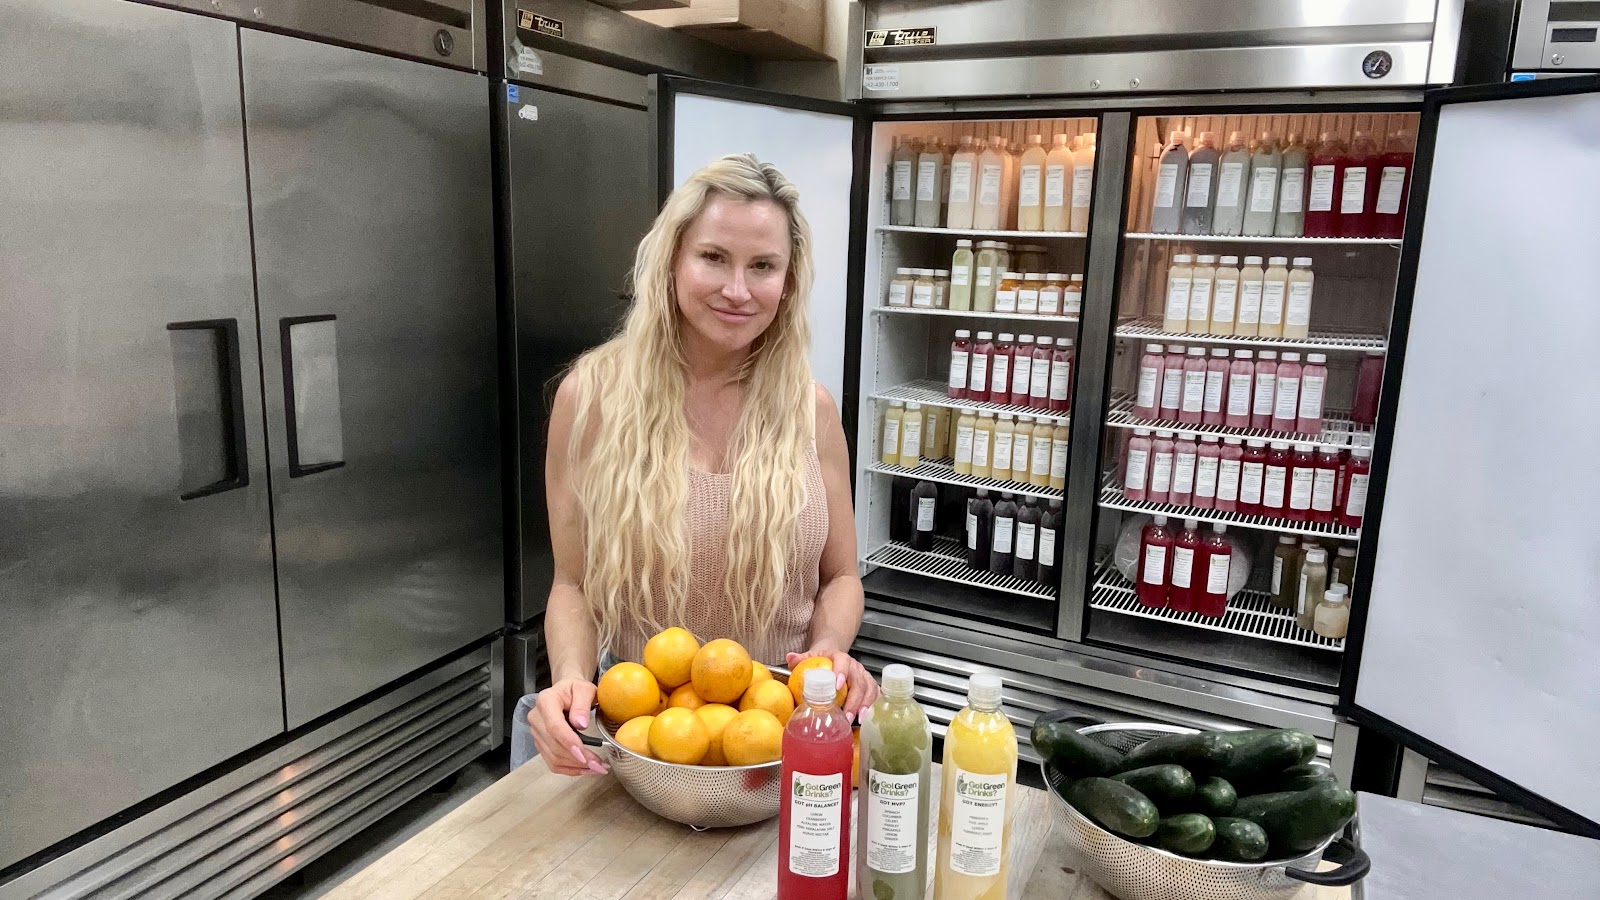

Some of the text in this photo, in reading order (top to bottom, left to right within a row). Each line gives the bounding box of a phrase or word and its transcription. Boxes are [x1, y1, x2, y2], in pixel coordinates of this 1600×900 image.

[805, 790, 833, 798] Drinks?
[880, 788, 909, 796] Drinks?
[968, 788, 997, 797] Drinks?
